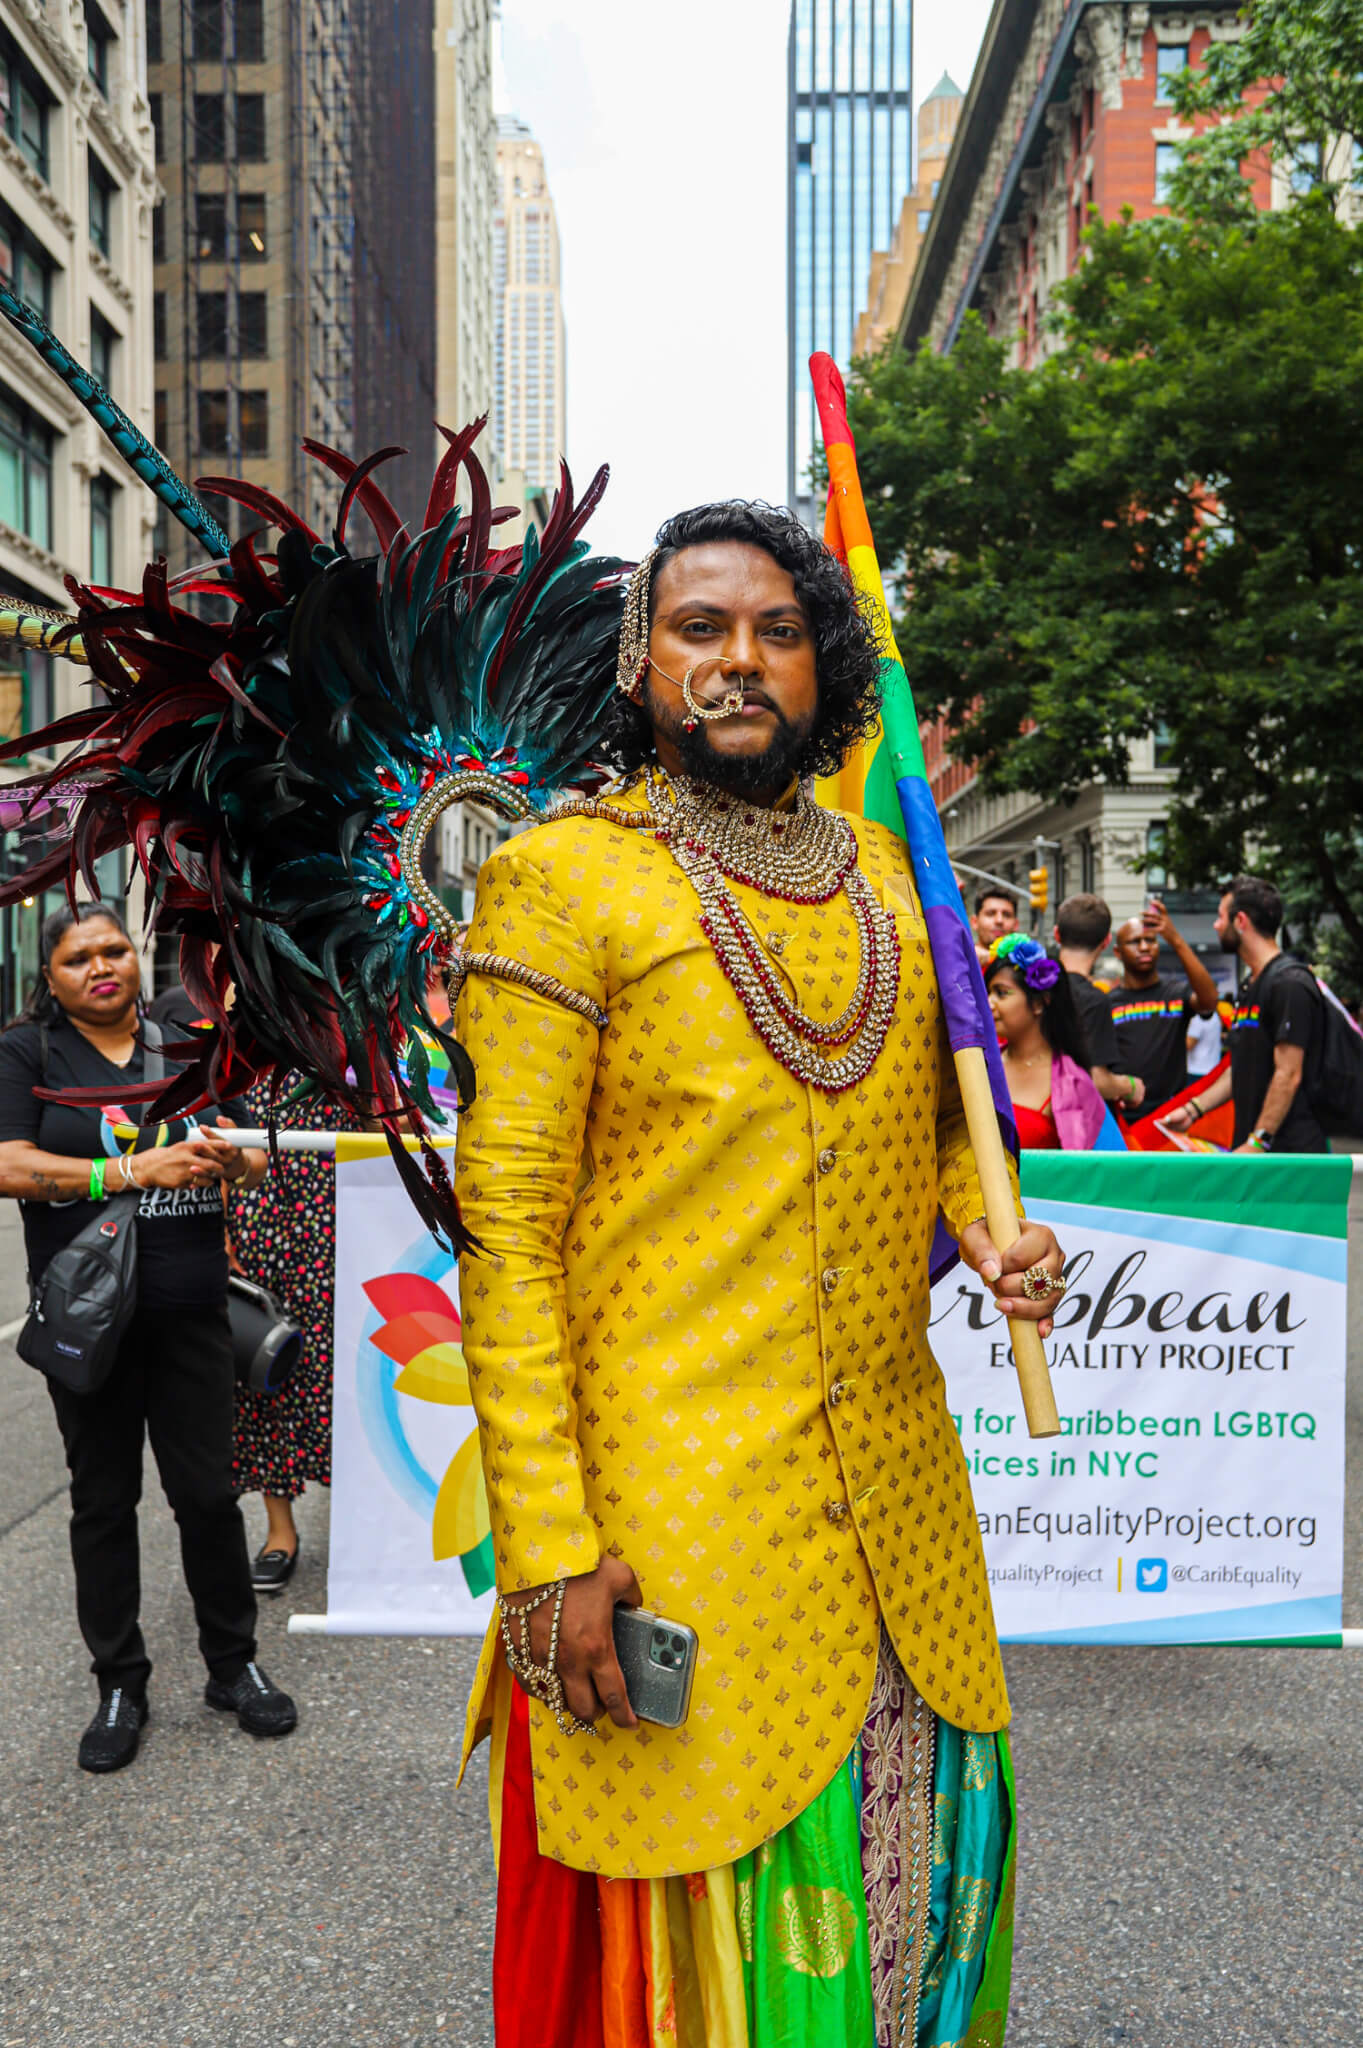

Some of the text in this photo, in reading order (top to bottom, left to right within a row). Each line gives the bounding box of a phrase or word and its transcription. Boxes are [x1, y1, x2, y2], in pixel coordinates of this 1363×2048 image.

[136, 1204, 195, 1219] QUALITY
[929, 1250, 1307, 1341] rbbean
[1159, 1343, 1296, 1376] PROJECT
[973, 1407, 1016, 1435] for
[1058, 1409, 1200, 1437] aribbean
[1213, 1411, 1317, 1440] LGBTQ
[965, 1448, 1159, 1479] ices in NYC
[1171, 1565, 1302, 1589] @CaribEquality
